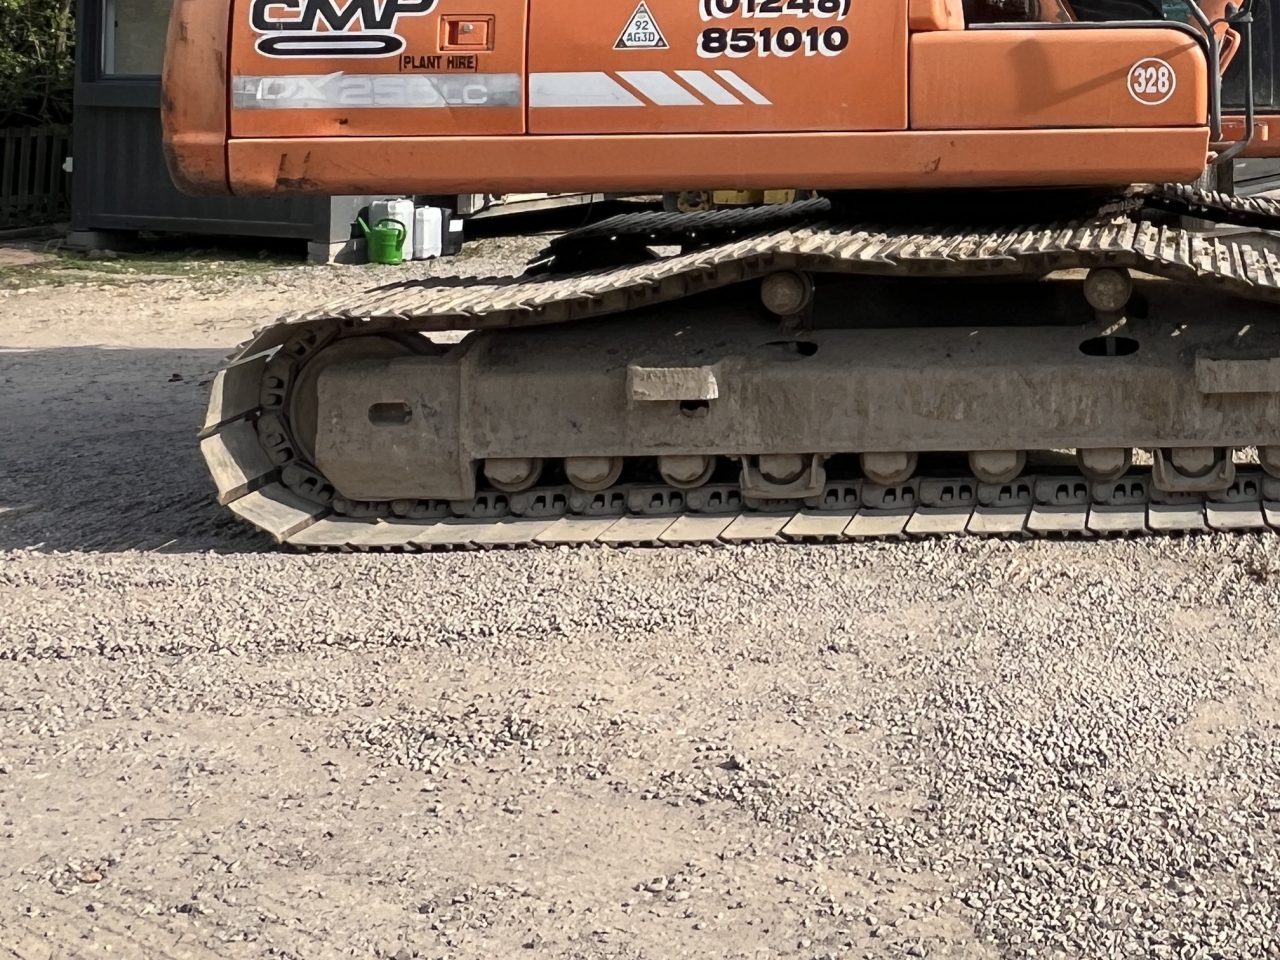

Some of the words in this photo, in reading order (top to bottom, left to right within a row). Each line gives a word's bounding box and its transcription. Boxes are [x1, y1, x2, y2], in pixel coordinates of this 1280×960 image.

[635, 20, 649, 30] 92
[626, 32, 655, 42] AG3D
[698, 25, 848, 57] 851010
[1133, 66, 1169, 94] 328
